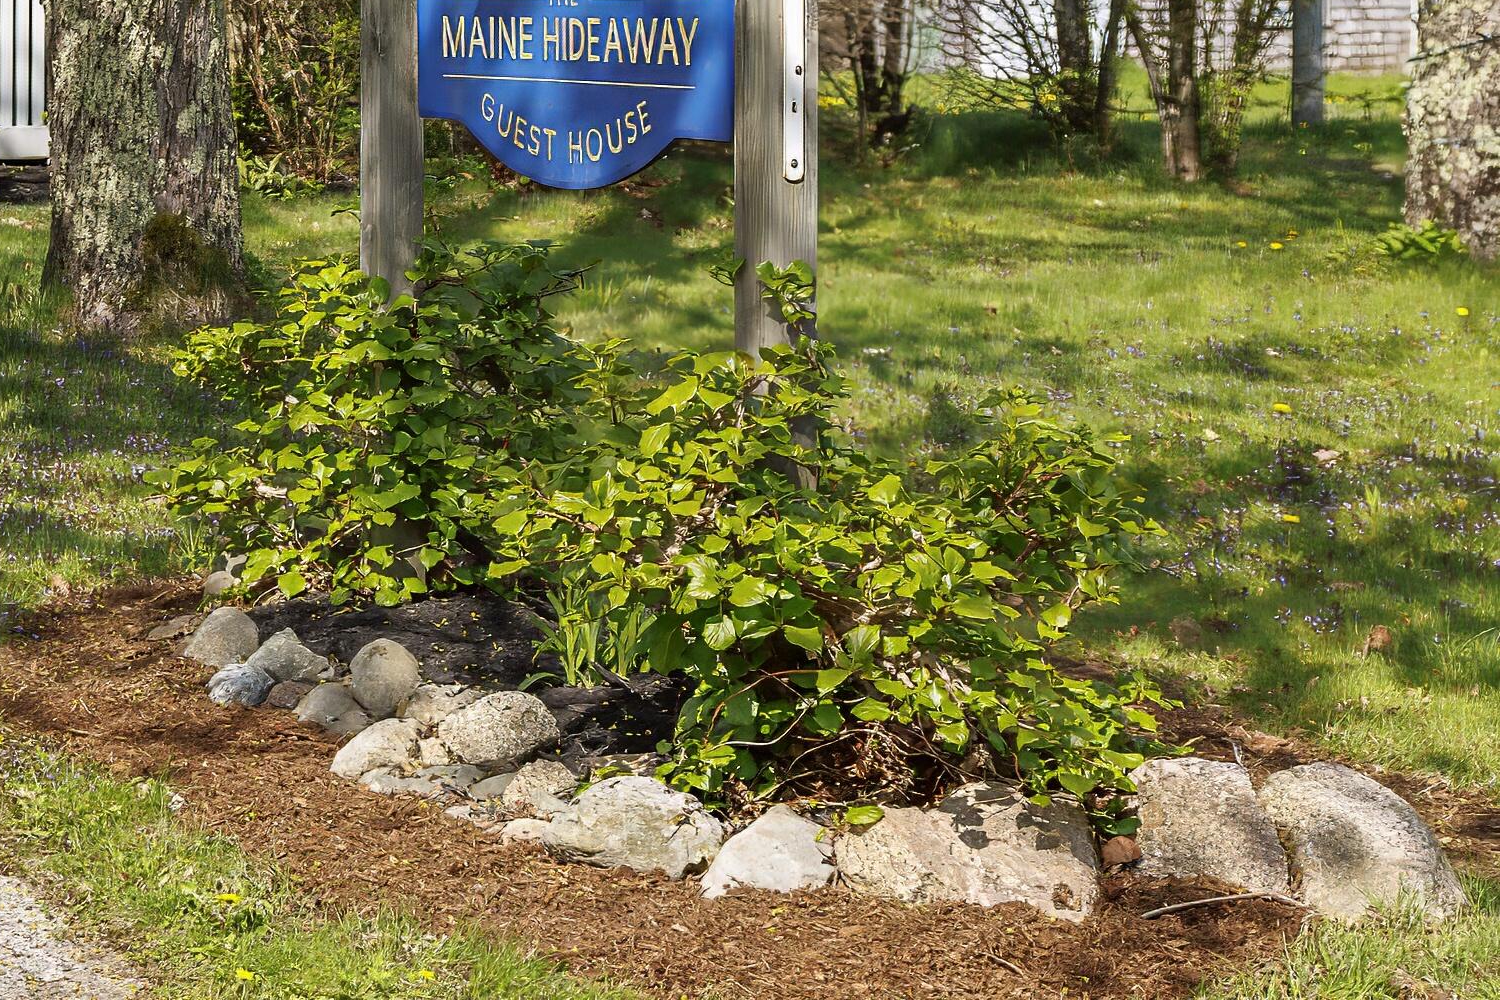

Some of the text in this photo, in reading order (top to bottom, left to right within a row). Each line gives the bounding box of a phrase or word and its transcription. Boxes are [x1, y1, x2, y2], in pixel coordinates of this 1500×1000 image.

[442, 15, 699, 66] MAINE HIDEAWAY
[481, 93, 652, 164] GUEST HOUSE
